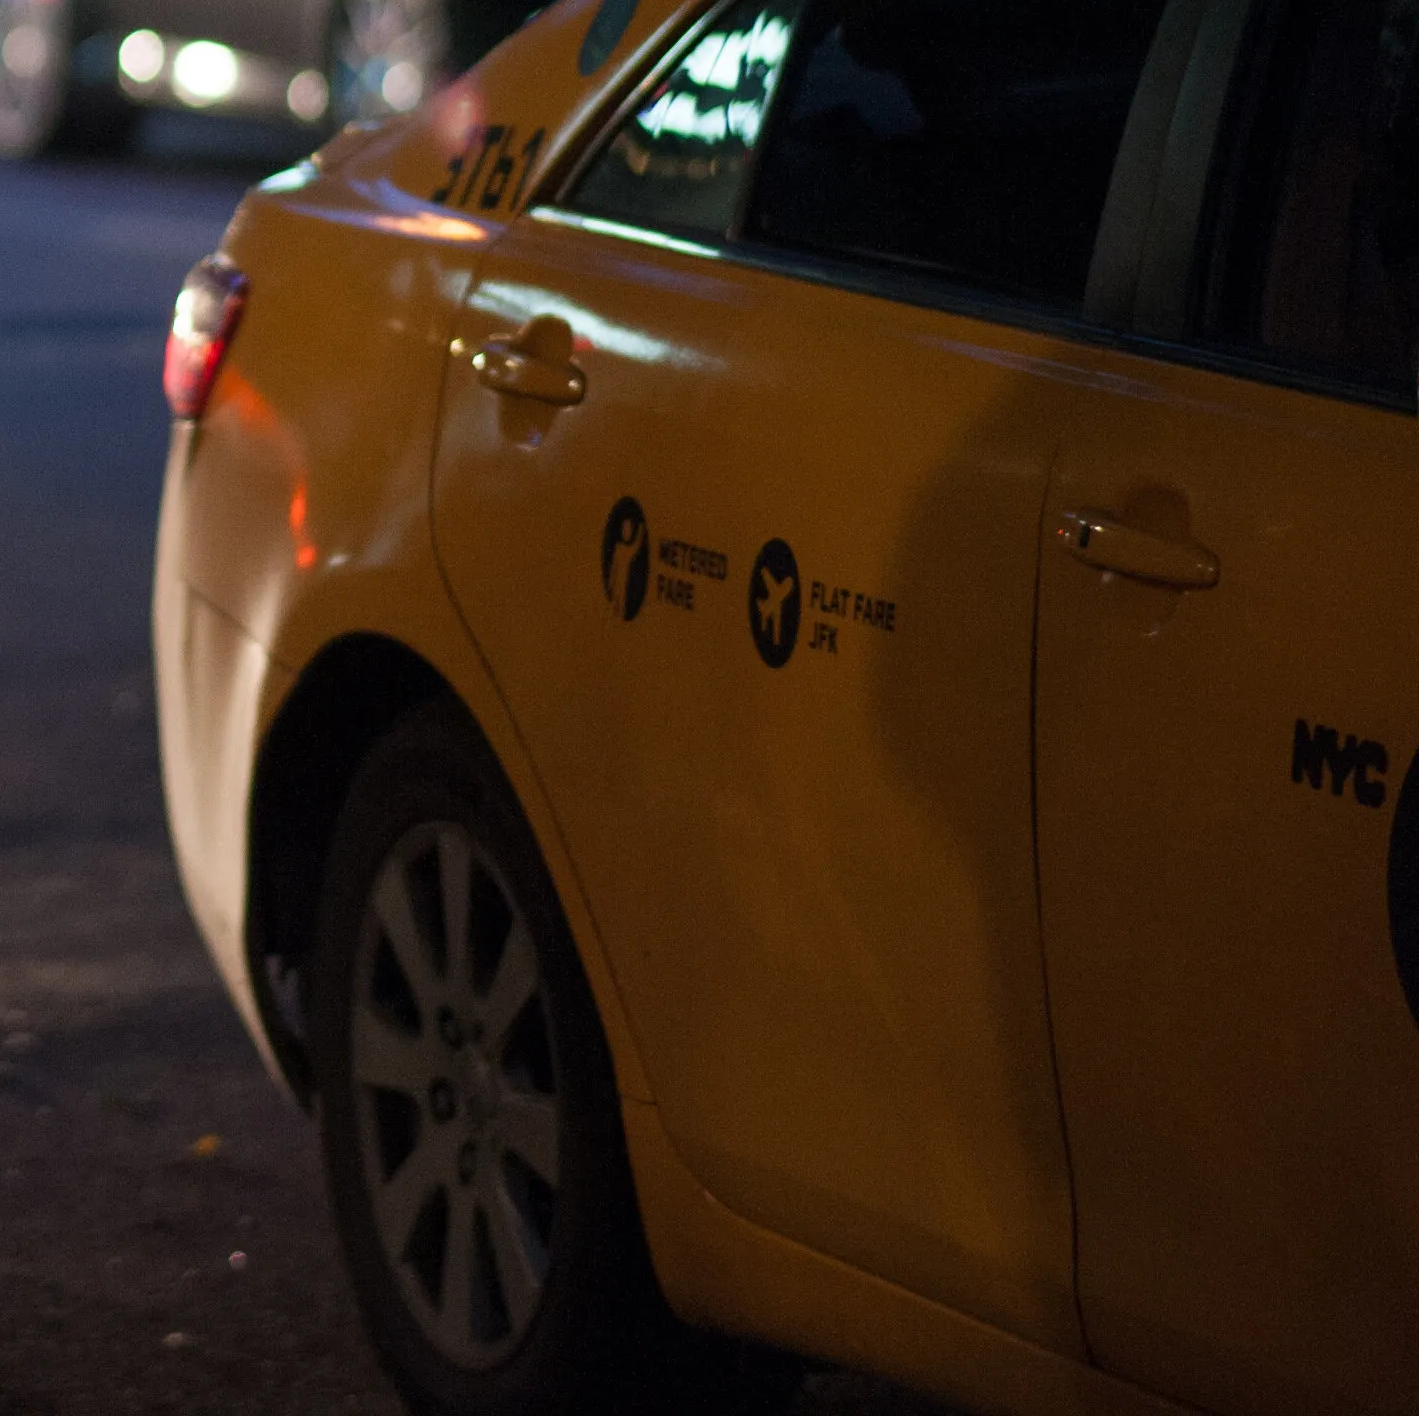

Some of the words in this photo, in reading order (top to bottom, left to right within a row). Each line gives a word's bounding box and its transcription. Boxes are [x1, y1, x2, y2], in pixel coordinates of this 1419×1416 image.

[659, 539, 728, 581] METERED
[657, 574, 695, 611] FARE
[811, 581, 850, 618] FLAT
[853, 593, 896, 632] FARE
[809, 621, 839, 654] JFK
[1291, 718, 1389, 809] NYC
